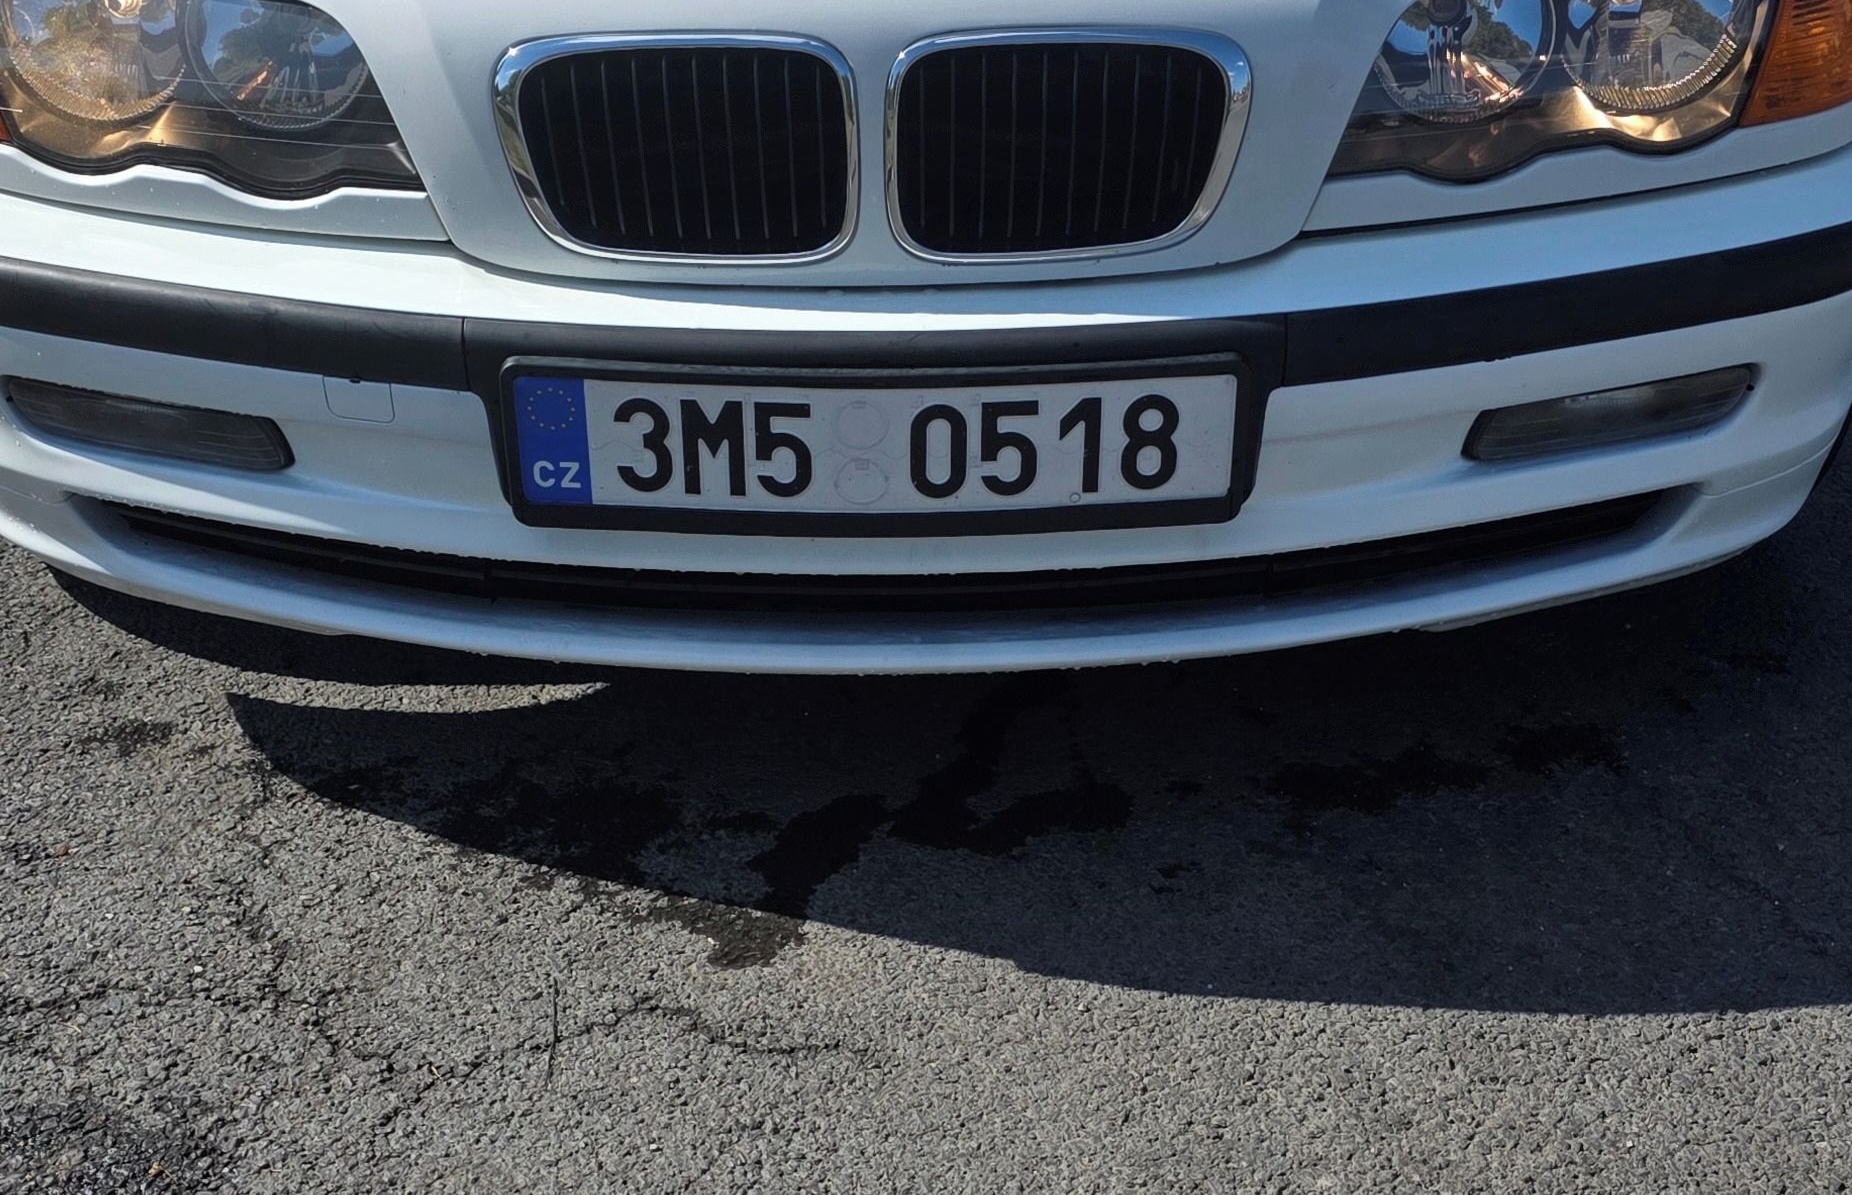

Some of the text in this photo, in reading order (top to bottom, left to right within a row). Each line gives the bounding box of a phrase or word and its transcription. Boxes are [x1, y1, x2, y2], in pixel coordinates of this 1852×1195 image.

[532, 460, 582, 488] CZ
[612, 393, 1180, 500] 3M5 0518
